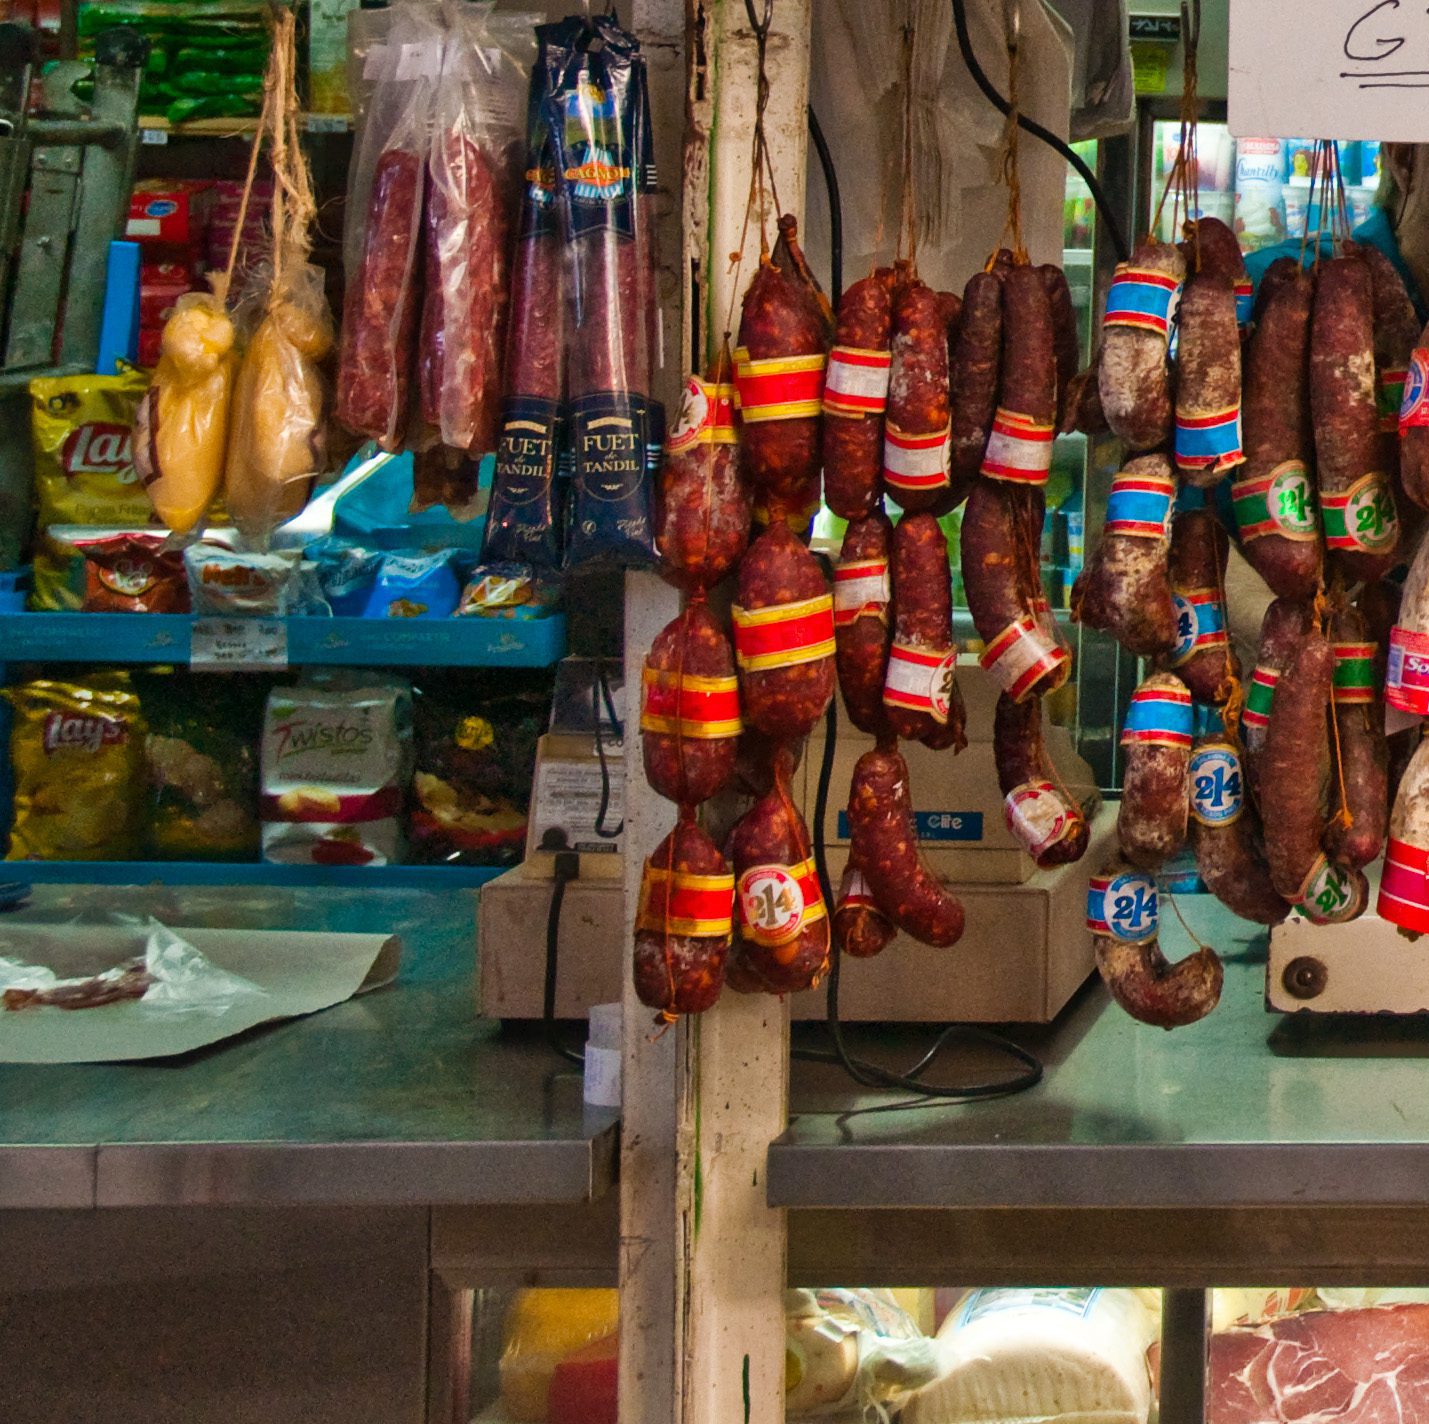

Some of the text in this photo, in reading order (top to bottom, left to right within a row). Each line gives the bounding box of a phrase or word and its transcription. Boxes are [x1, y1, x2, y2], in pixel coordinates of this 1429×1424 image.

[583, 432, 639, 454] FUET
[583, 458, 640, 473] TANDIL
[1193, 765, 1241, 808] 214
[1112, 886, 1157, 928] 214
